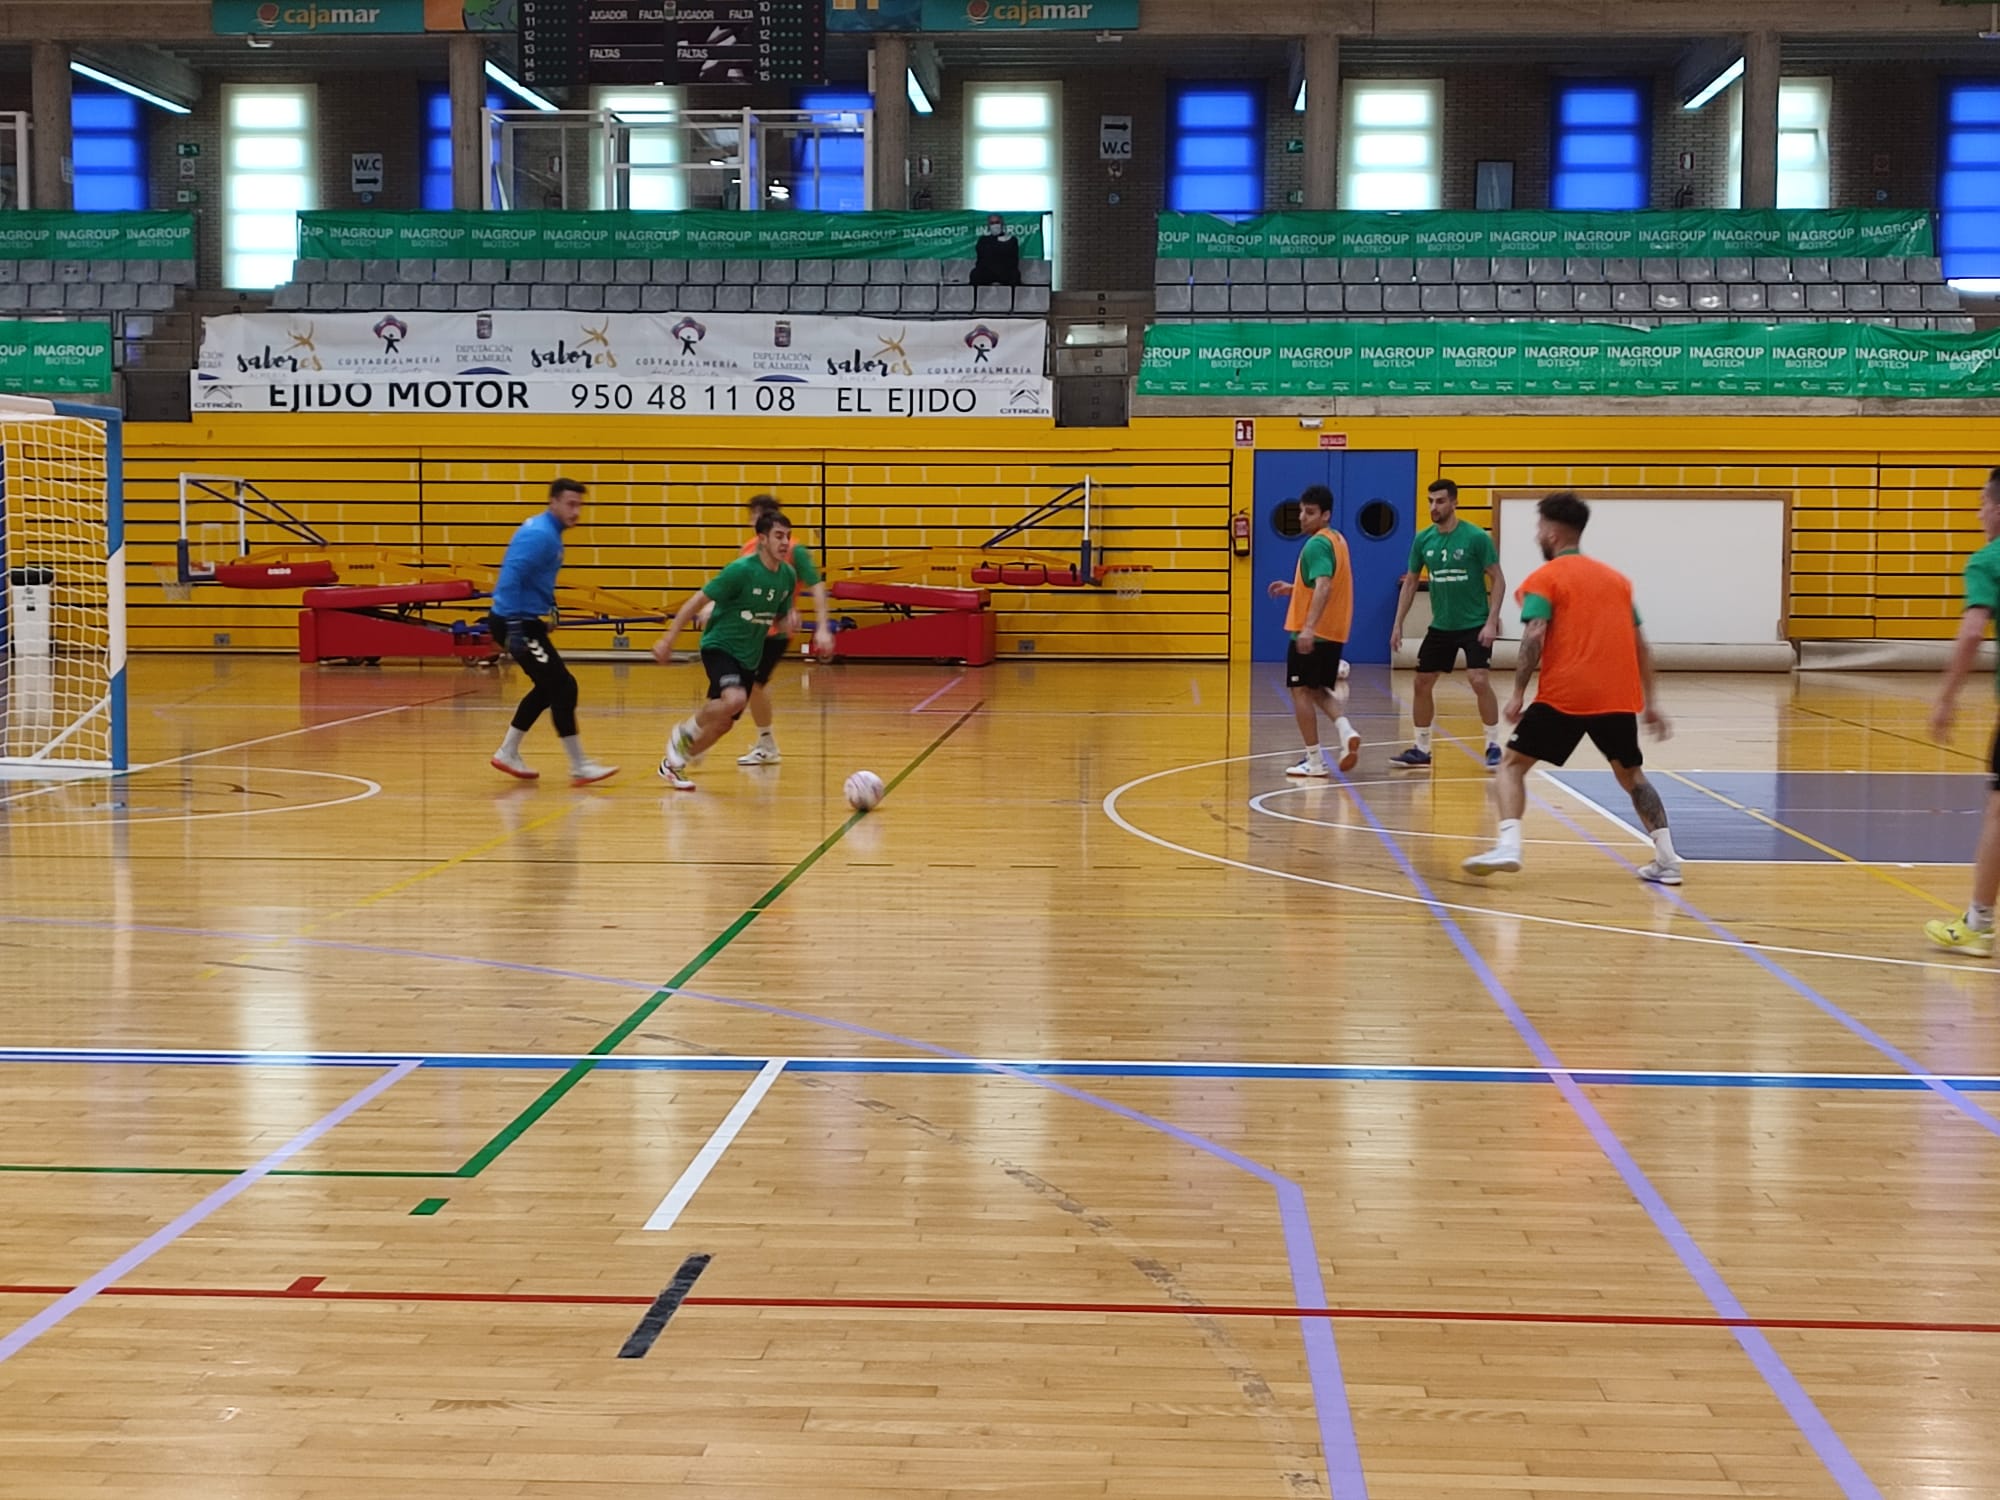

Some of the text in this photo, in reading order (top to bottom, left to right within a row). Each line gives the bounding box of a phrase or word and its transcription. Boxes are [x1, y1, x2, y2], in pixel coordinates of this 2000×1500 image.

[524, 2, 536, 12] 10
[759, 2, 770, 12] 10
[283, 3, 380, 30] cajamar
[589, 10, 628, 20] JUGADOR
[676, 10, 714, 19] JUGADOR
[993, 0, 1093, 26] cajamar
[526, 17, 536, 26] 11
[761, 16, 770, 26] 11
[524, 31, 536, 41] 12
[759, 30, 770, 40] 12
[524, 45, 536, 54] 13
[589, 49, 620, 59] FALTAS
[677, 49, 708, 59] FALTAS
[759, 44, 770, 54] 13
[524, 58, 536, 68] 14
[759, 58, 770, 67] 14
[524, 72, 536, 82] 15
[759, 72, 770, 81] 15
[1102, 140, 1130, 154] W.C
[354, 158, 380, 172] W.C
[56, 228, 120, 240] INAGROUP
[126, 228, 190, 240] INAGROUP
[330, 227, 394, 239] INAGROUP
[400, 228, 465, 240] INAGROUP
[472, 229, 536, 240] INAGROUP
[543, 230, 608, 241] INAGROUP
[615, 230, 680, 242] INAGROUP
[687, 230, 752, 242] INAGROUP
[758, 230, 824, 242] INAGROUP
[830, 229, 896, 240] INAGROUP
[903, 226, 968, 238] INAGROUP
[1197, 232, 1262, 245] INAGROUP
[1269, 234, 1336, 245] INAGROUP
[1342, 234, 1410, 244] INAGROUP
[1416, 231, 1483, 243] INAGROUP
[1490, 230, 1556, 242] INAGROUP
[1564, 230, 1632, 242] INAGROUP
[1638, 230, 1706, 242] INAGROUP
[1714, 230, 1780, 242] INAGROUP
[1787, 228, 1854, 242] INAGROUP
[34, 344, 104, 356] INAGROUP
[455, 344, 513, 353] DIPUTACIÓN
[237, 345, 322, 372] sabores
[456, 354, 470, 363] DE
[531, 340, 618, 368] sabores
[753, 352, 812, 362] DIPUTACIÓN
[1198, 347, 1272, 359] INAGROUP
[1279, 347, 1353, 359] INAGROUP
[1360, 346, 1435, 358] INAGROUP
[1442, 346, 1517, 358] INAGROUP
[1524, 346, 1600, 358] INAGROUP
[1607, 346, 1682, 358] INAGROUP
[1689, 346, 1764, 358] INAGROUP
[1772, 347, 1848, 359] INAGROUP
[1855, 348, 1929, 362] INAGROUP
[45, 356, 85, 365] BIOTECH
[827, 348, 913, 377] sabores
[1210, 360, 1252, 368] BIOTECH
[1292, 359, 1334, 368] BIOTECH
[1373, 359, 1415, 368] BIOTECH
[1454, 359, 1497, 368] BIOTECH
[1537, 358, 1580, 368] BIOTECH
[1619, 358, 1662, 368] BIOTECH
[1702, 359, 1745, 368] BIOTECH
[1784, 359, 1828, 368] BIOTECH
[1868, 360, 1910, 370] BIOTECH
[754, 362, 766, 370] DE
[270, 381, 977, 418] EJIDO MOTOR 950 48 11 08 EL EJIDO
[766, 588, 776, 602] 5
